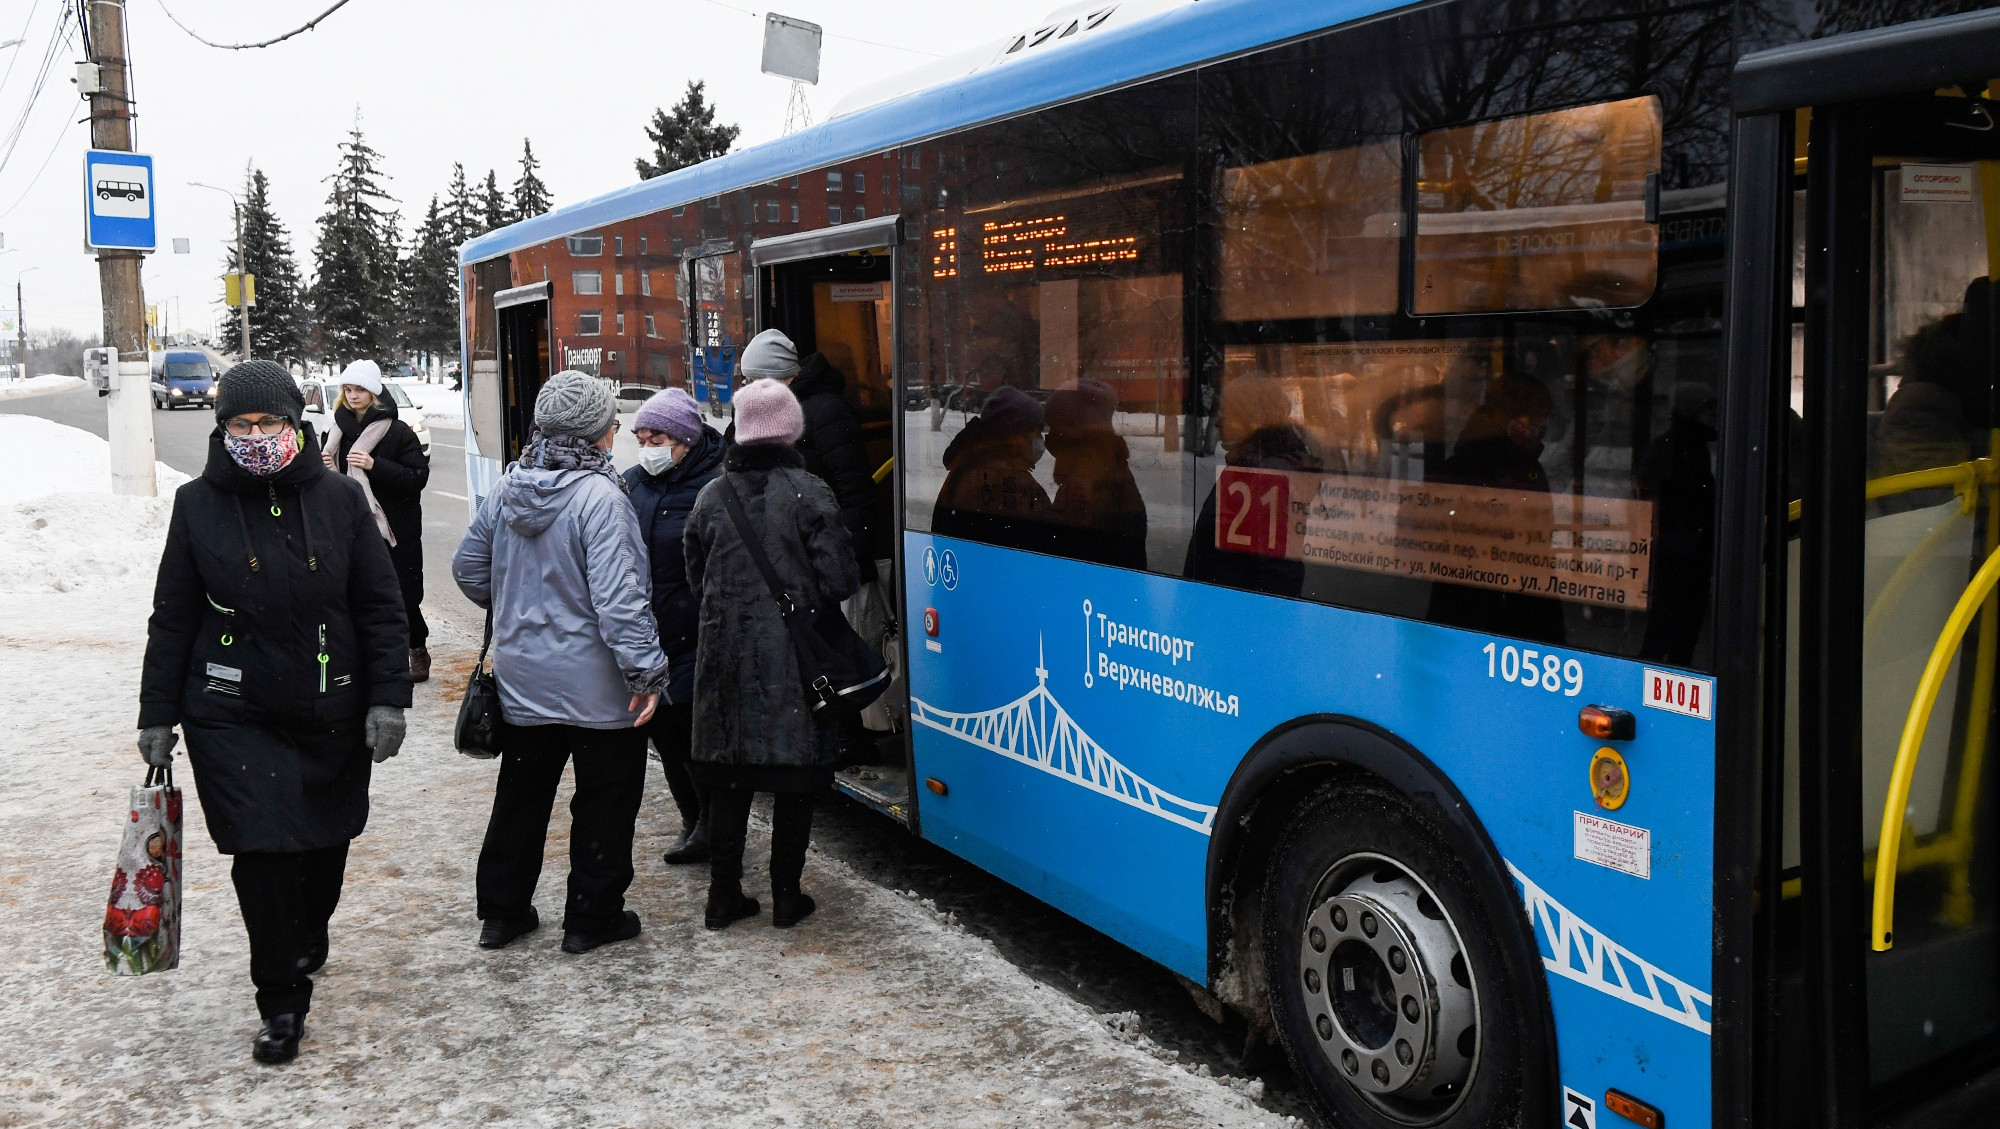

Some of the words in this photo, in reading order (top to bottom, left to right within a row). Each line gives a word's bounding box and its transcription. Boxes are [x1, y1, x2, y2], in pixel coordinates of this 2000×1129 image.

[564, 346, 603, 371] Транспорт
[1226, 481, 1279, 550] 21
[1317, 481, 1380, 502] Мигалово
[1295, 522, 1350, 541] Советская
[1377, 532, 1450, 554] Смоленский
[1491, 546, 1602, 576] Волоколамский
[1607, 564, 1639, 582] пр-т
[1303, 543, 1374, 567] Октябрьский
[1376, 556, 1401, 571] пр-т
[1408, 560, 1426, 576] ул.
[1429, 563, 1509, 586] Можайского
[1519, 575, 1541, 592] ул.
[1545, 576, 1626, 604] Левитана
[1096, 612, 1195, 667] Транспорт
[1098, 652, 1239, 718] Верхневолжья
[1482, 641, 1584, 697] 10589
[1653, 676, 1700, 714] ВХОД
[1579, 816, 1599, 828] ПРИ
[1602, 823, 1644, 839] АВАРИИ
